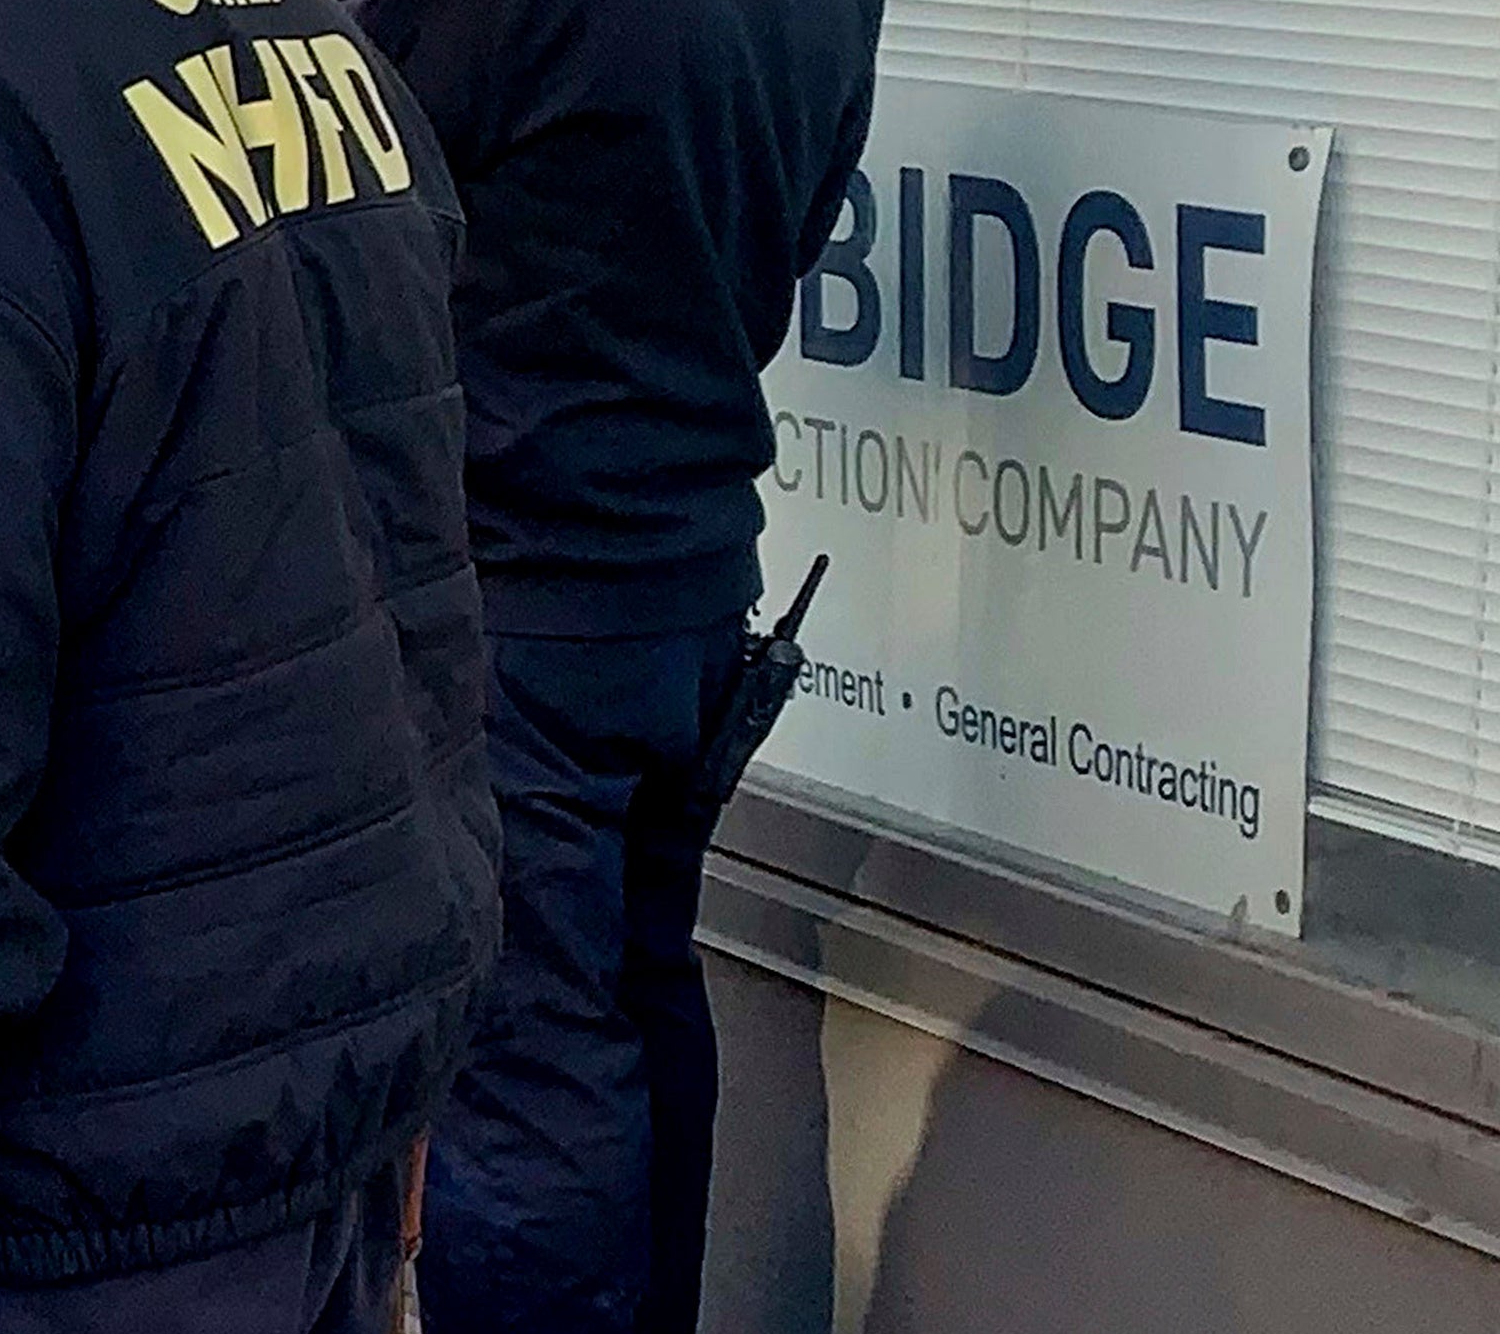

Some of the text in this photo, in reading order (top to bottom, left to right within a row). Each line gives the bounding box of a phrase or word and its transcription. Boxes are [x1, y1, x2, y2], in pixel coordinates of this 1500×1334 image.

[122, 33, 412, 250] NHFD
[955, 450, 1267, 598] COMPANY
[936, 687, 1057, 765] General
[1070, 726, 1261, 837] Contracting
